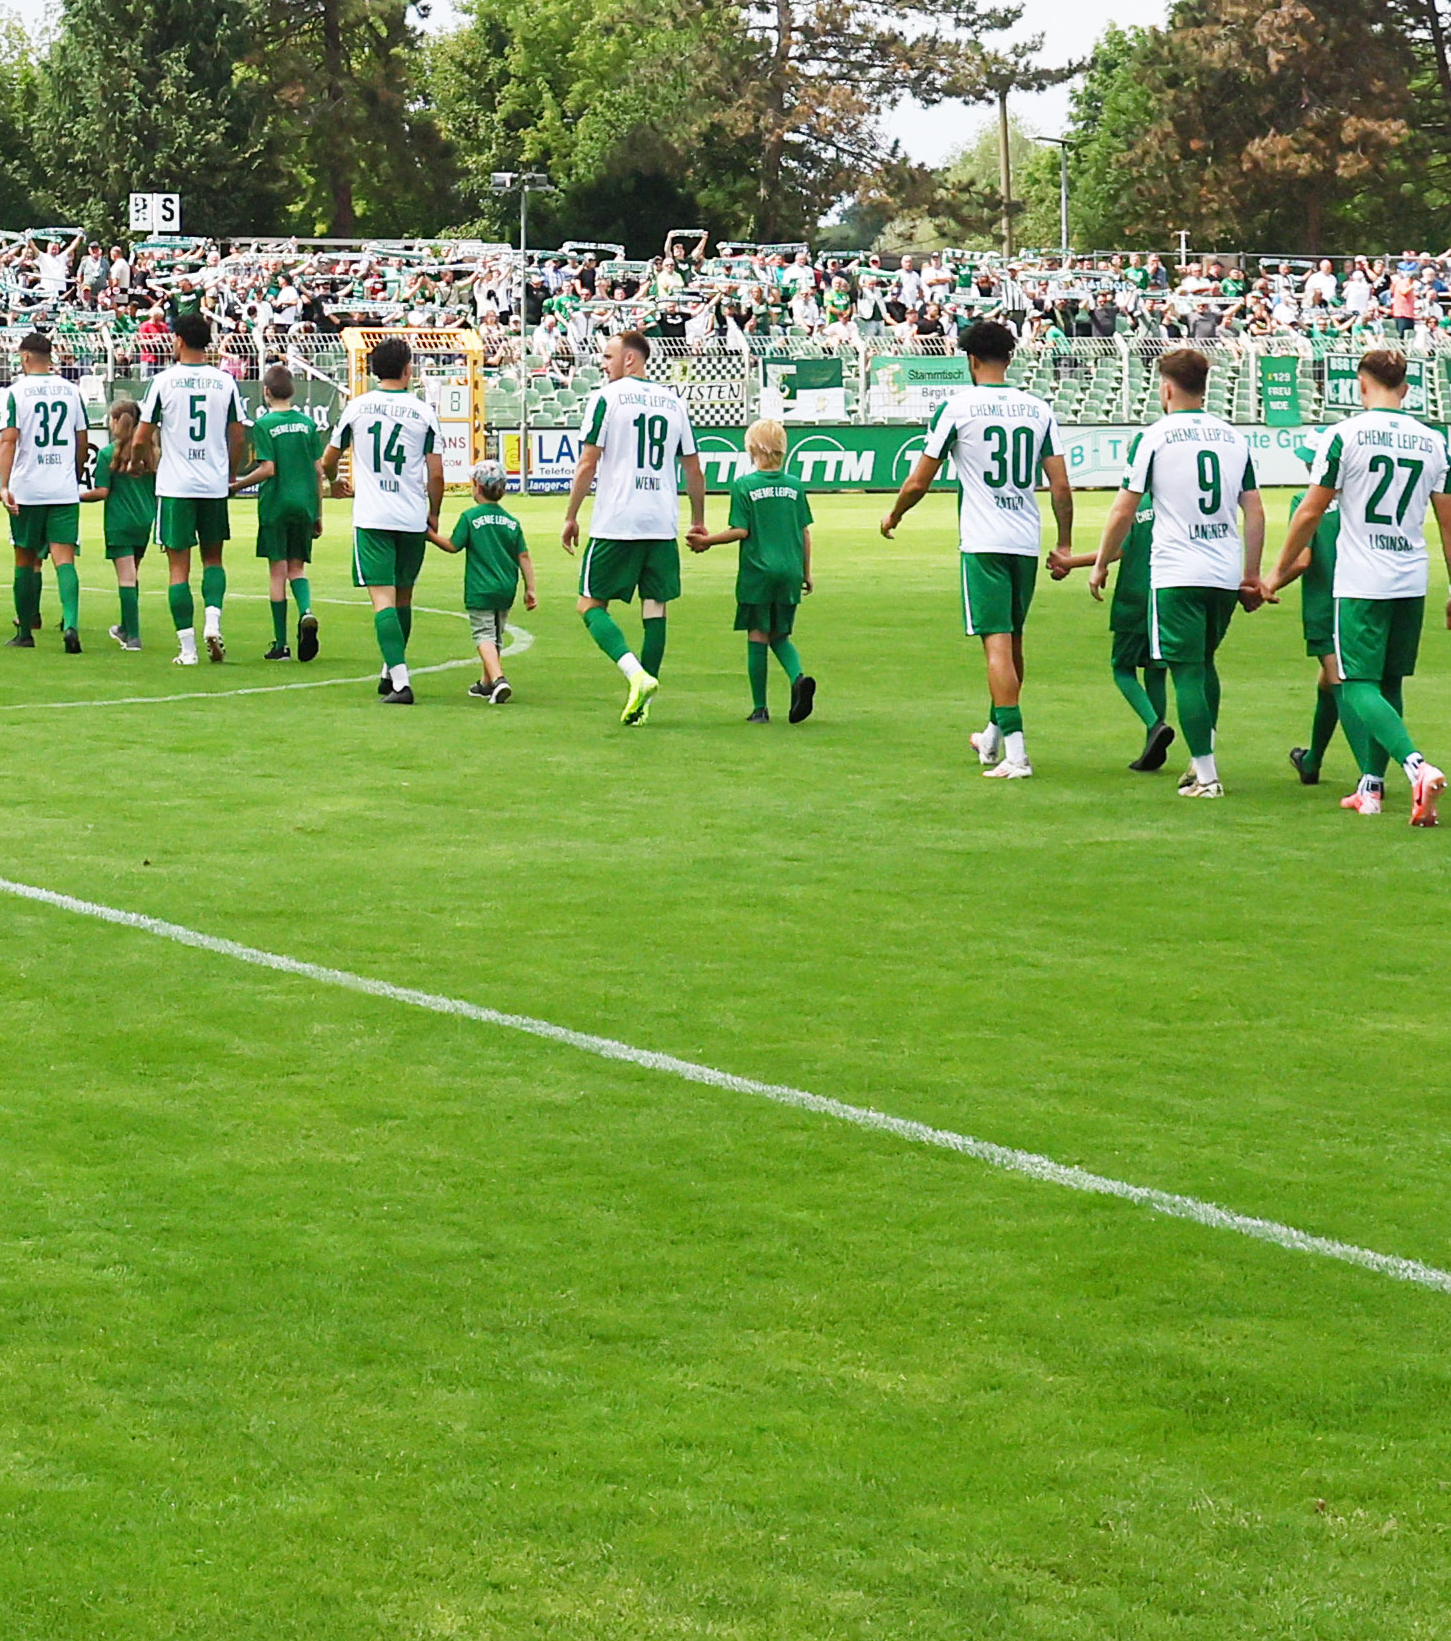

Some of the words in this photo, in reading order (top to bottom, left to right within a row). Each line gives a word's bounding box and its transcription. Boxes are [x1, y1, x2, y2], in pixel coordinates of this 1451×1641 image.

[161, 197, 175, 222] S
[170, 378, 196, 390] CHEMIE
[907, 368, 965, 381] Stammtisch
[1267, 386, 1291, 396] FREU
[189, 394, 207, 442] 5
[360, 403, 389, 416] CHEMIE
[970, 404, 1005, 419] CHEMIE
[1007, 403, 1040, 419] LEIPZIG
[34, 400, 69, 448] 32
[1165, 430, 1200, 444] CHEMIE
[1203, 428, 1236, 444] LEIPZIG
[367, 420, 407, 476] 14
[538, 434, 581, 465] LA
[633, 412, 669, 472] 18
[1357, 429, 1393, 446] CHEMIE
[1397, 431, 1434, 453] LEIPZIG
[188, 448, 206, 461] ENKE
[796, 450, 876, 482] TTM
[983, 425, 1035, 490] 30
[1196, 449, 1222, 515] 9
[1365, 454, 1425, 527] 27
[1188, 523, 1229, 541] LANGNER
